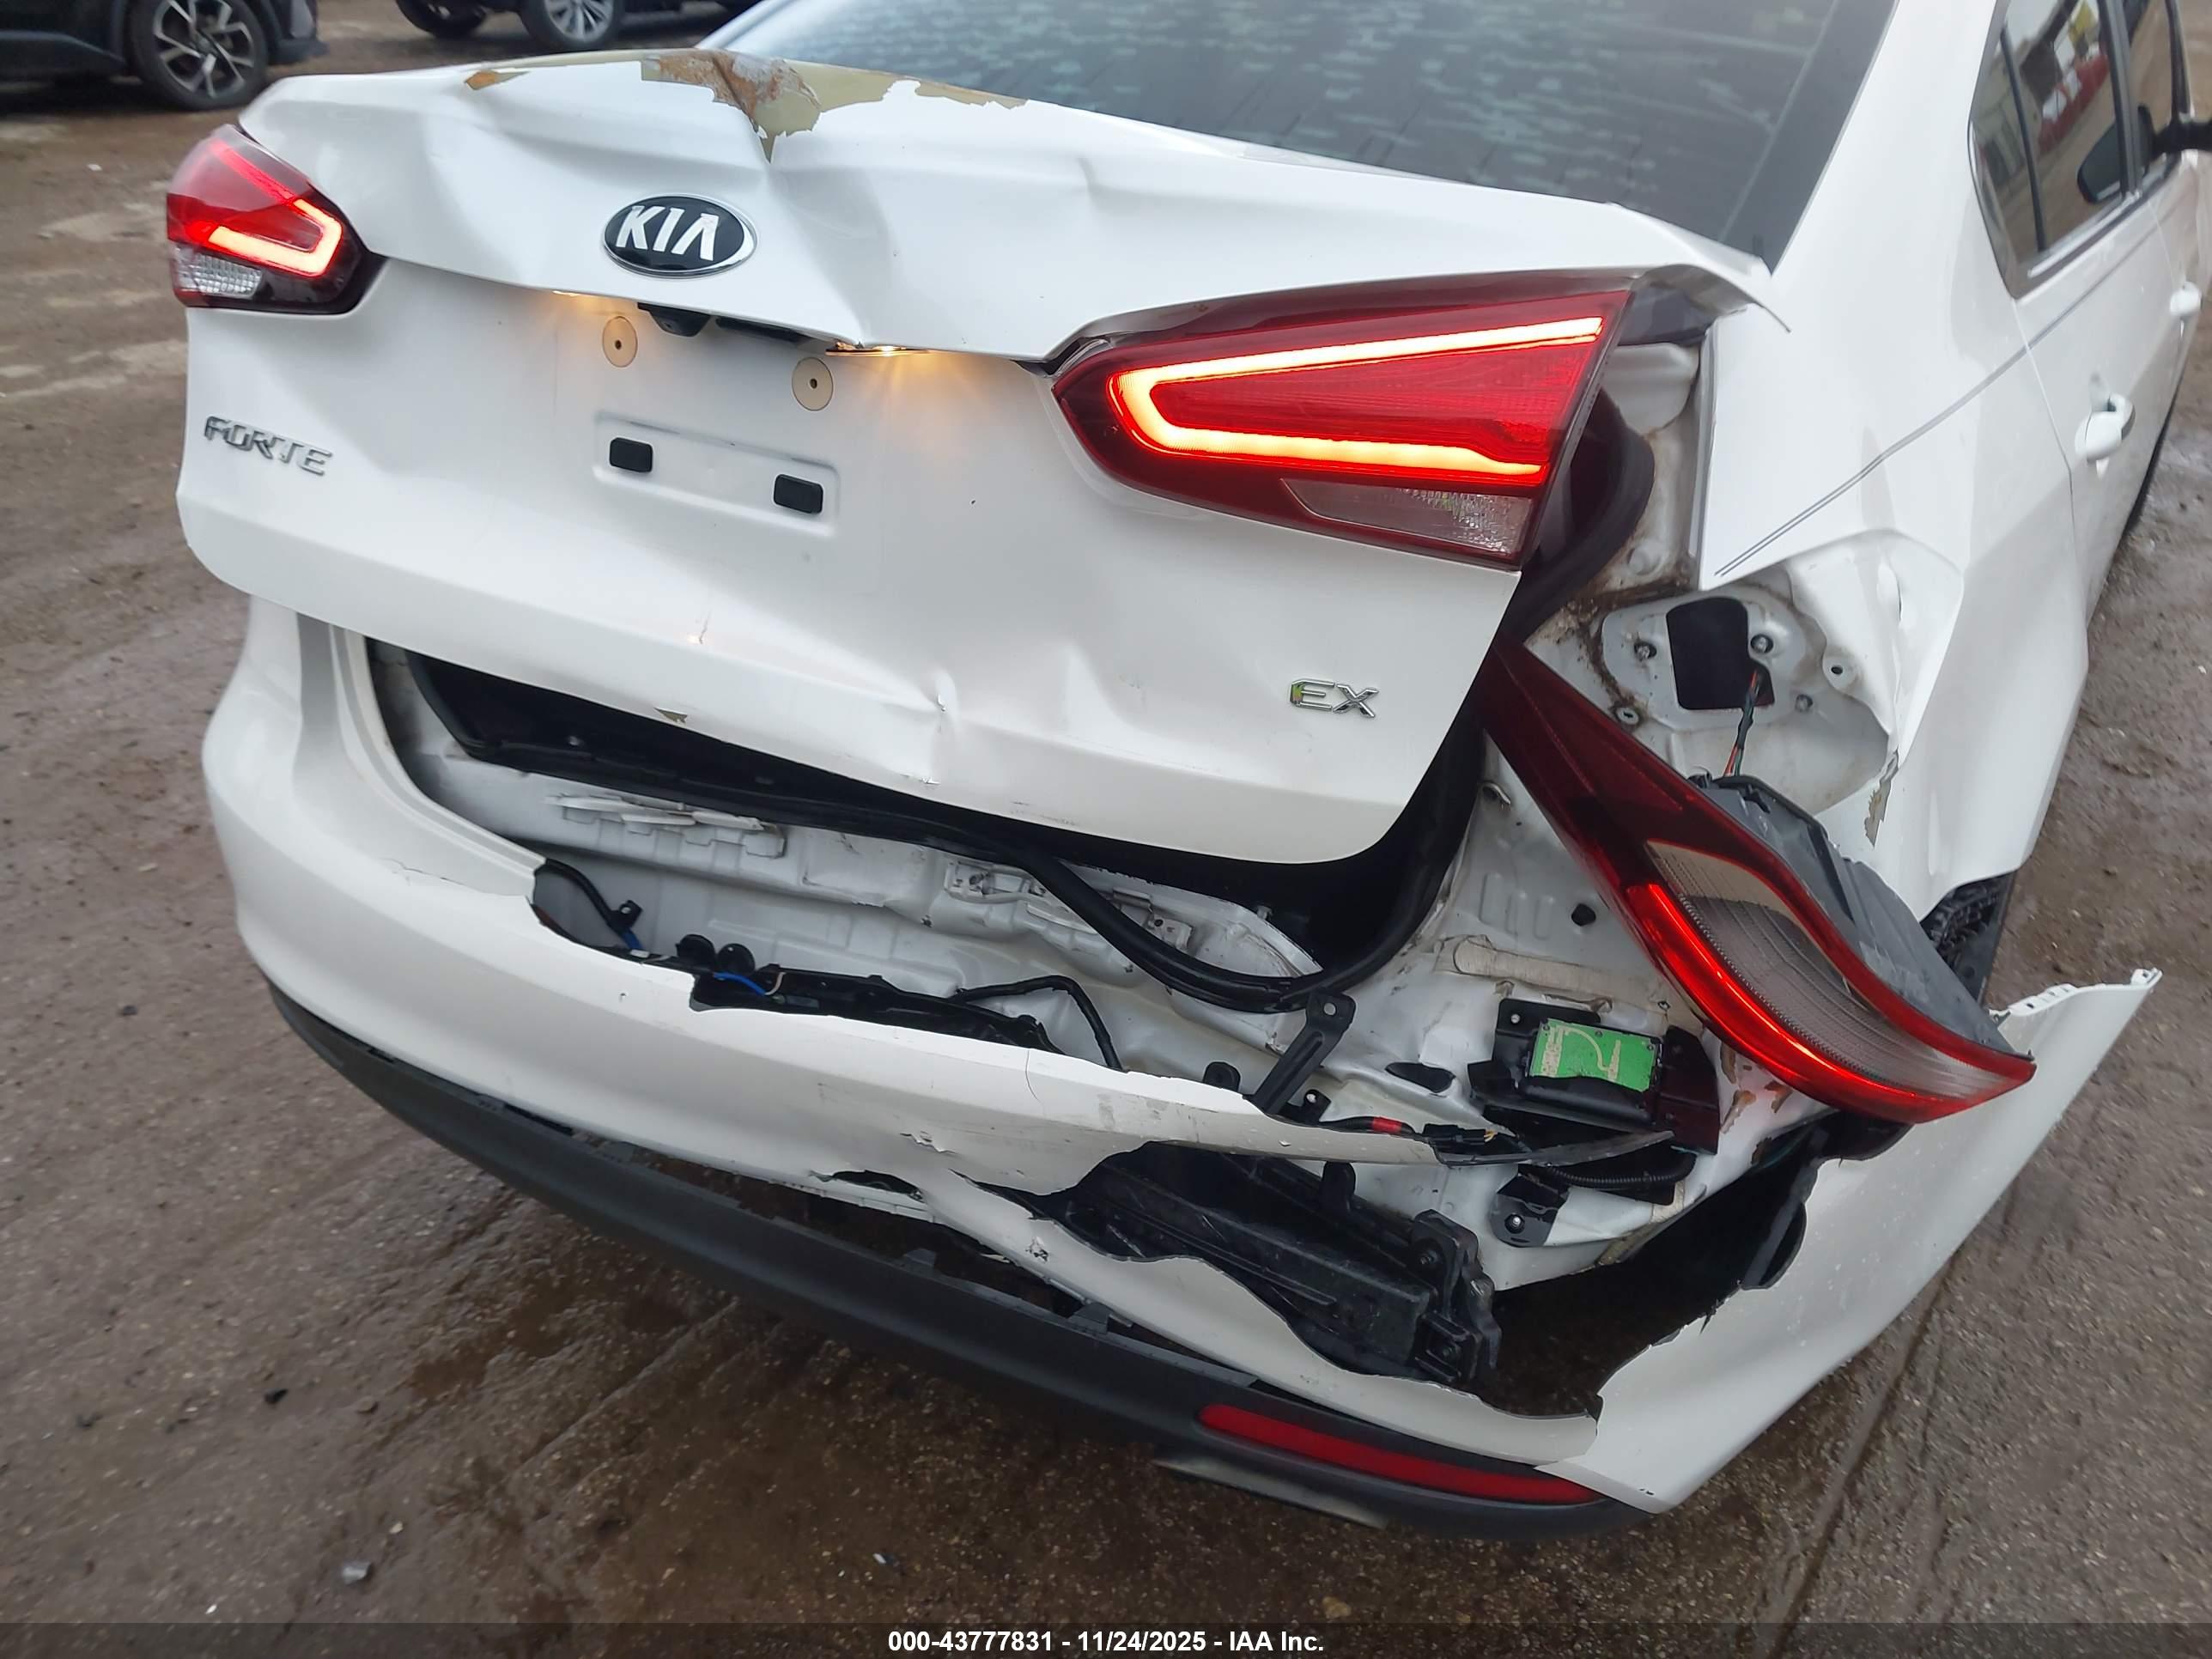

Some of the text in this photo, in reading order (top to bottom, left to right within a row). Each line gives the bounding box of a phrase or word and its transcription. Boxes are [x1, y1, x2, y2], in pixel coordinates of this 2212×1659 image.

[615, 204, 720, 262] KIA
[204, 416, 333, 477] FORTE
[1289, 678, 1379, 718] EX
